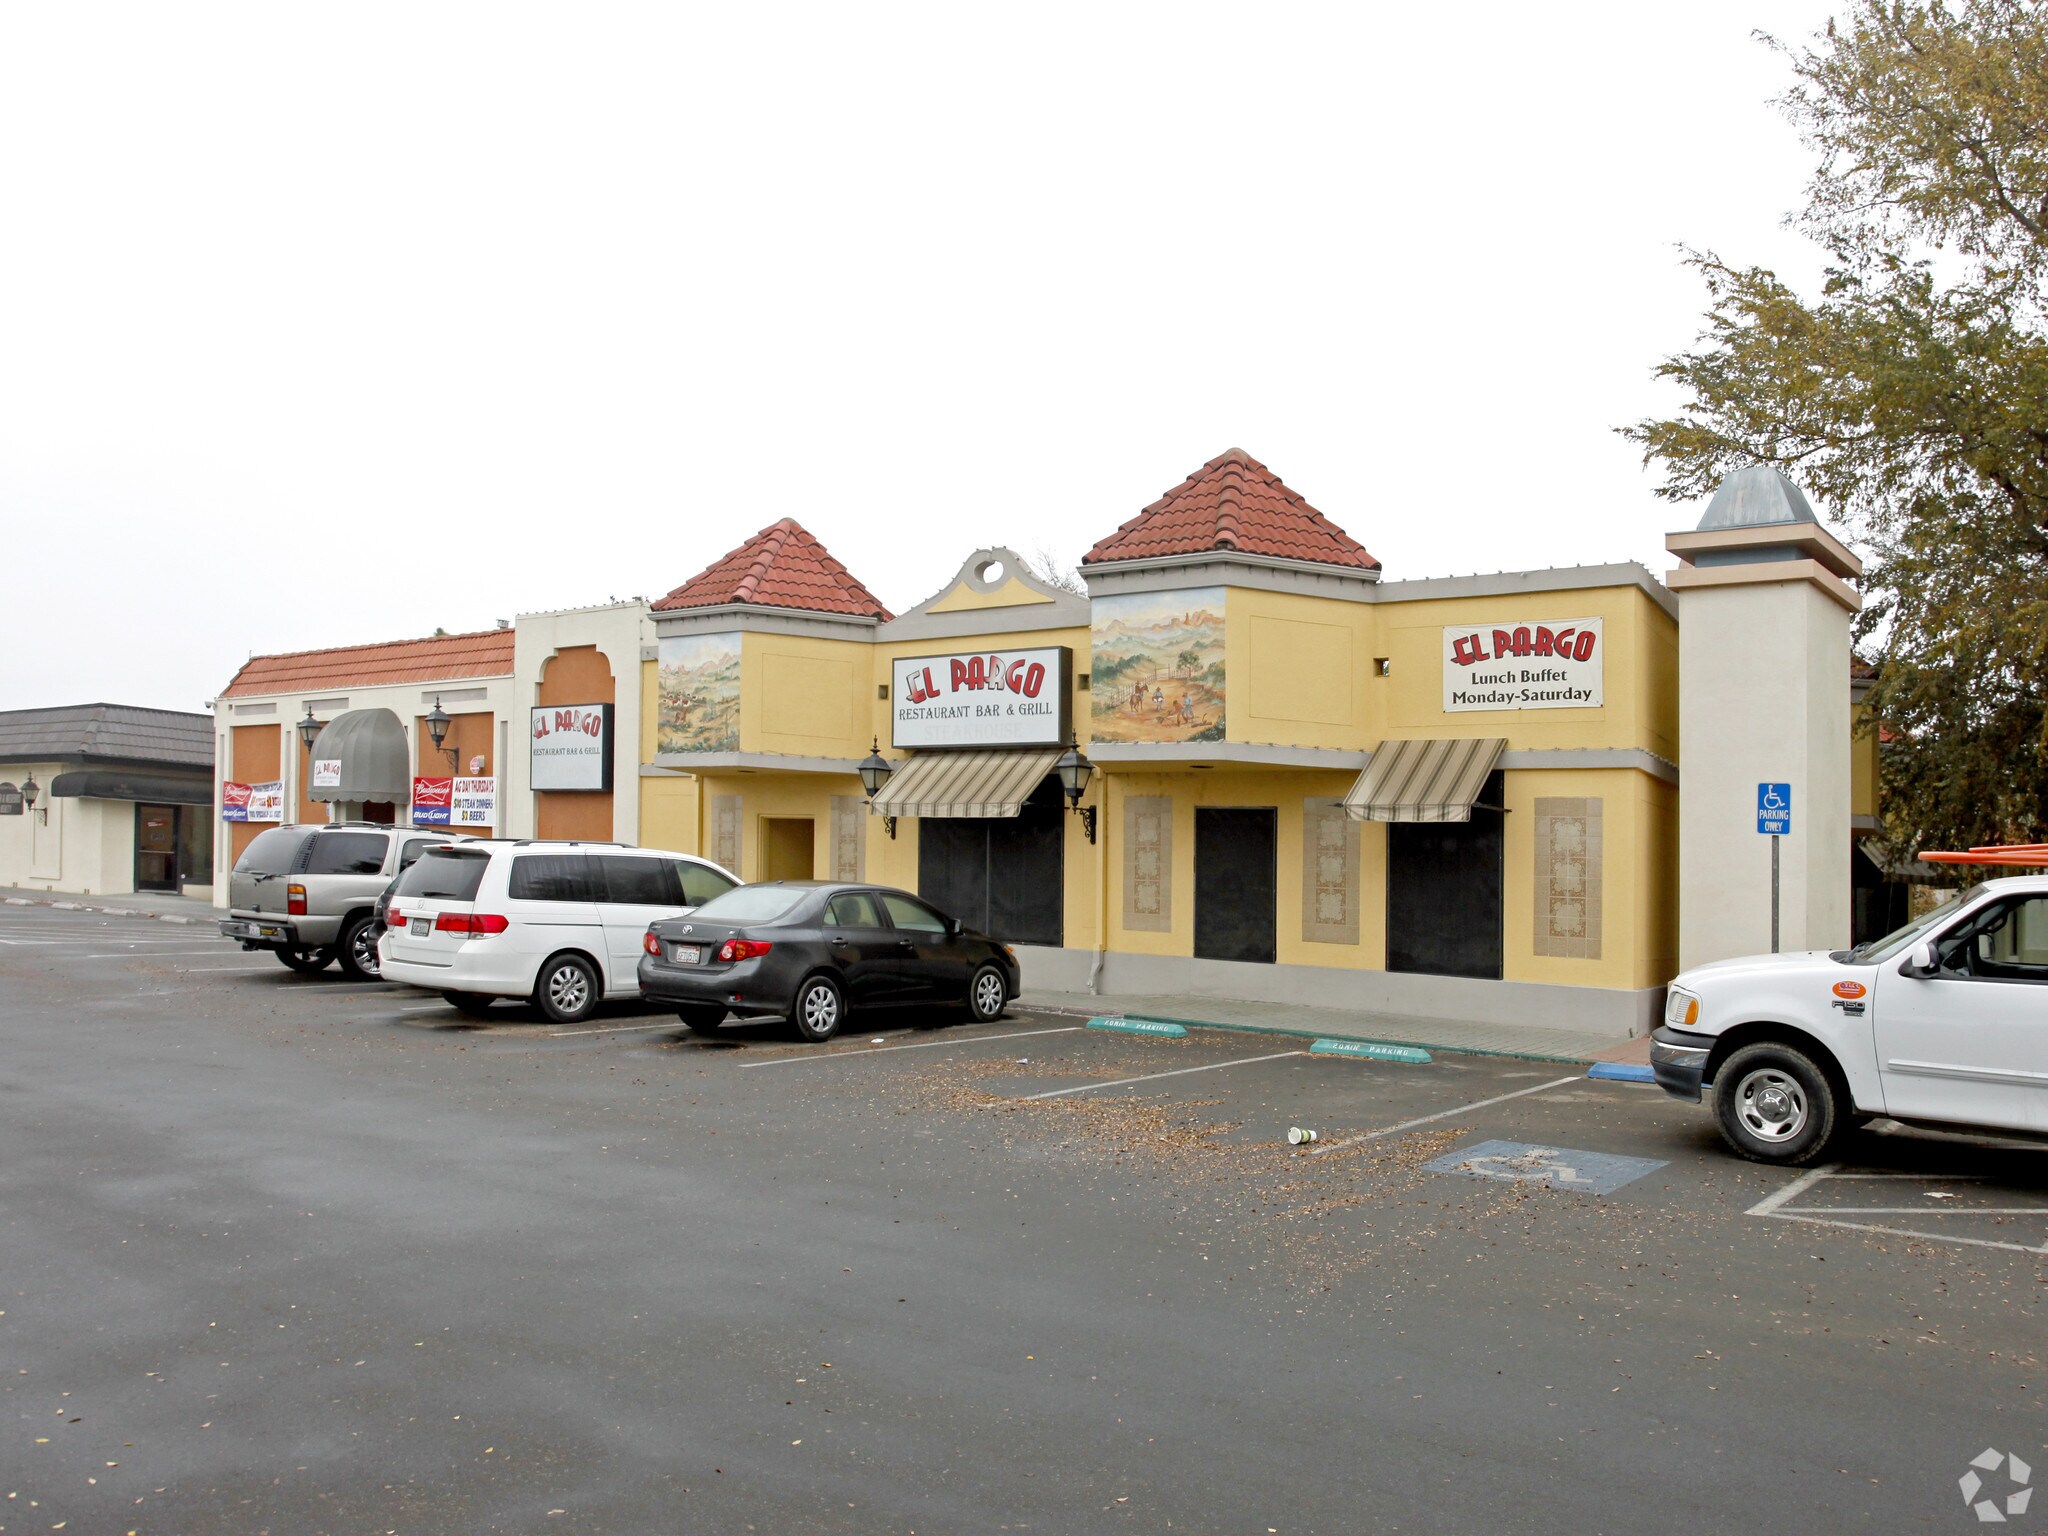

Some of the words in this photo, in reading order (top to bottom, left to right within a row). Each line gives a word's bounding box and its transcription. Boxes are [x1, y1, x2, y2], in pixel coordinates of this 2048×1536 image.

[1451, 634, 1490, 666] EL
[1492, 626, 1596, 662] PARGO
[906, 667, 940, 704] EL
[950, 655, 1046, 698] PARGO
[1471, 671, 1516, 685] Lunch
[1521, 669, 1567, 683] Buffet
[1452, 687, 1592, 704] Monday-Saturday
[899, 706, 970, 720] RESTAURANT
[976, 704, 1000, 717] BAR
[1006, 703, 1014, 715] &
[1018, 702, 1053, 716] GRILL
[533, 716, 550, 739] EL
[555, 710, 601, 737] PARGO
[462, 798, 476, 809] STEAK
[469, 810, 486, 821] BEERS
[1759, 809, 1789, 820] PARKING
[1764, 821, 1783, 832] ONLY
[1369, 1046, 1409, 1056] PARKING
